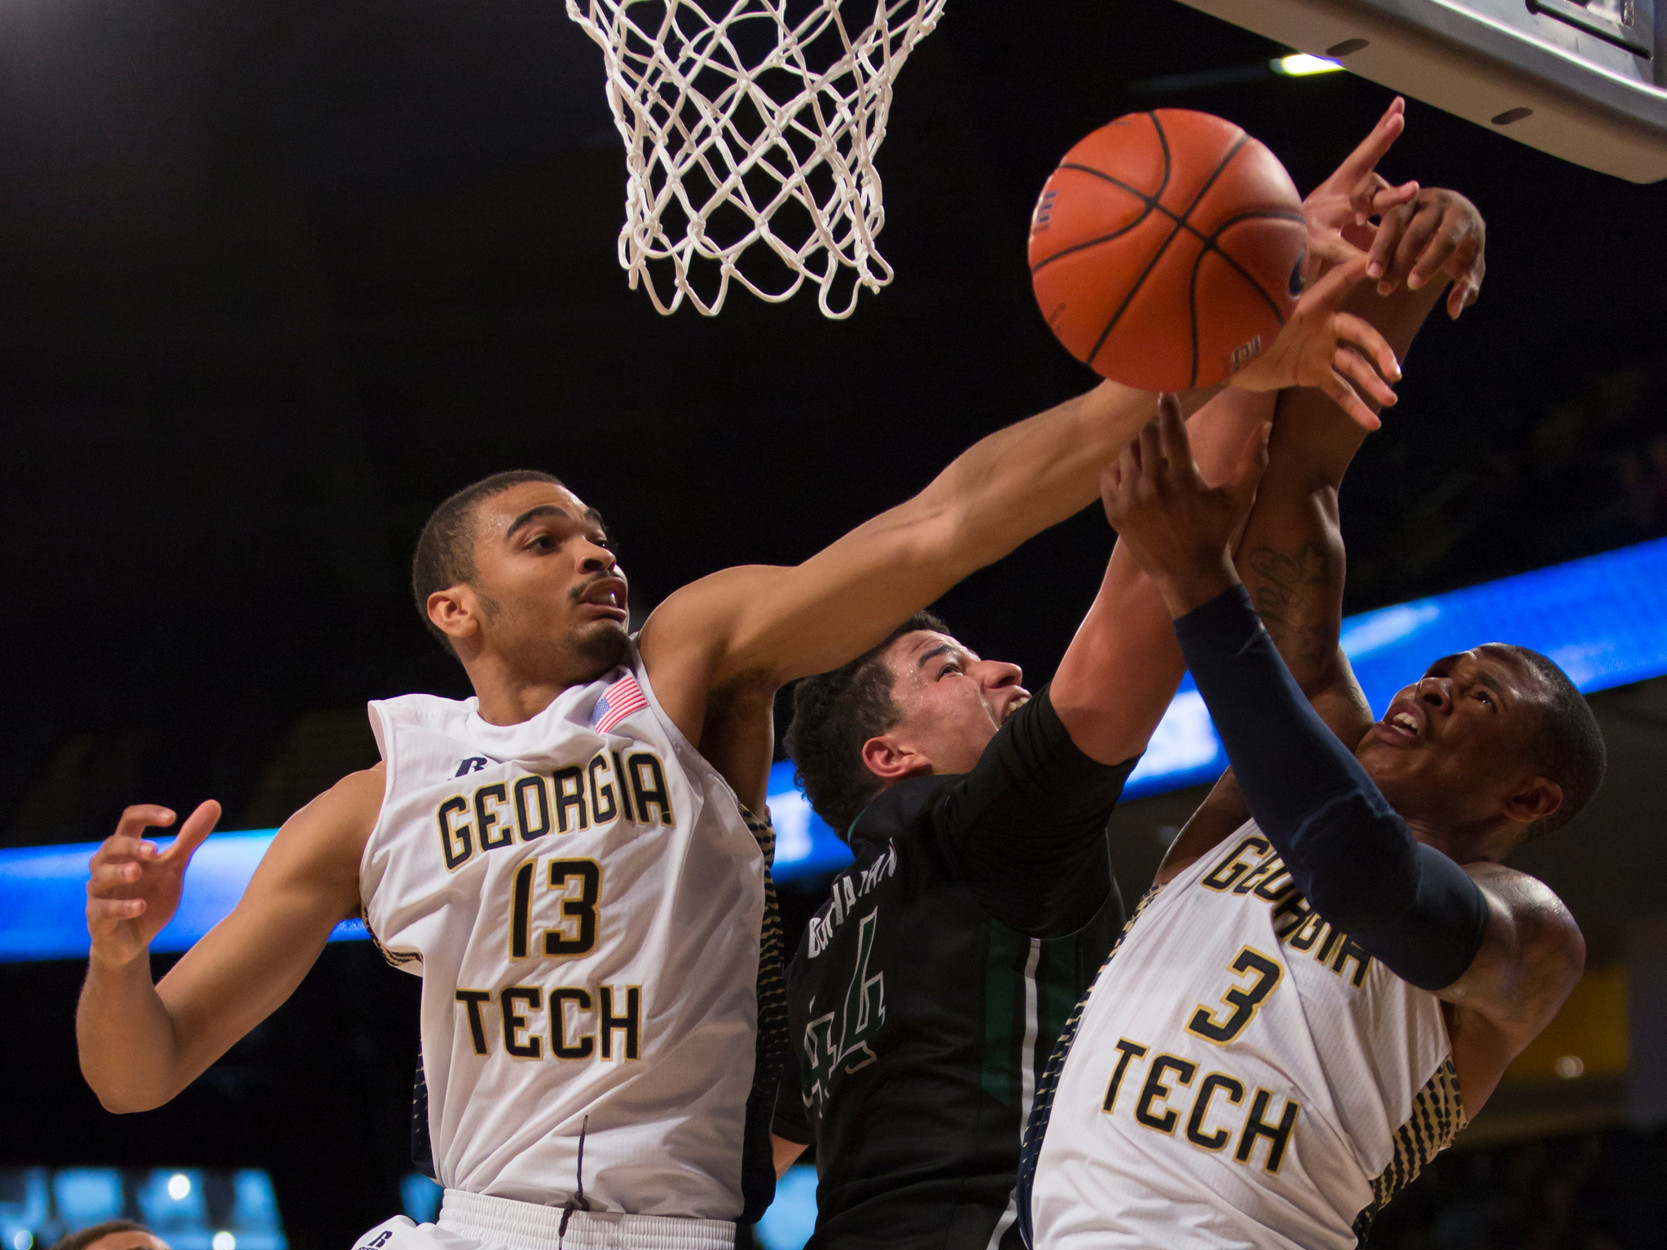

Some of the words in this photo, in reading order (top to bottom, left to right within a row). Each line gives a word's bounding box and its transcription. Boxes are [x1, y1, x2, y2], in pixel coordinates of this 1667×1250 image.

[436, 752, 674, 872] GEORGIA
[508, 857, 601, 962] 13
[455, 985, 642, 1062] TECH
[1184, 945, 1285, 1048] 3
[1103, 1037, 1300, 1174] TECH
